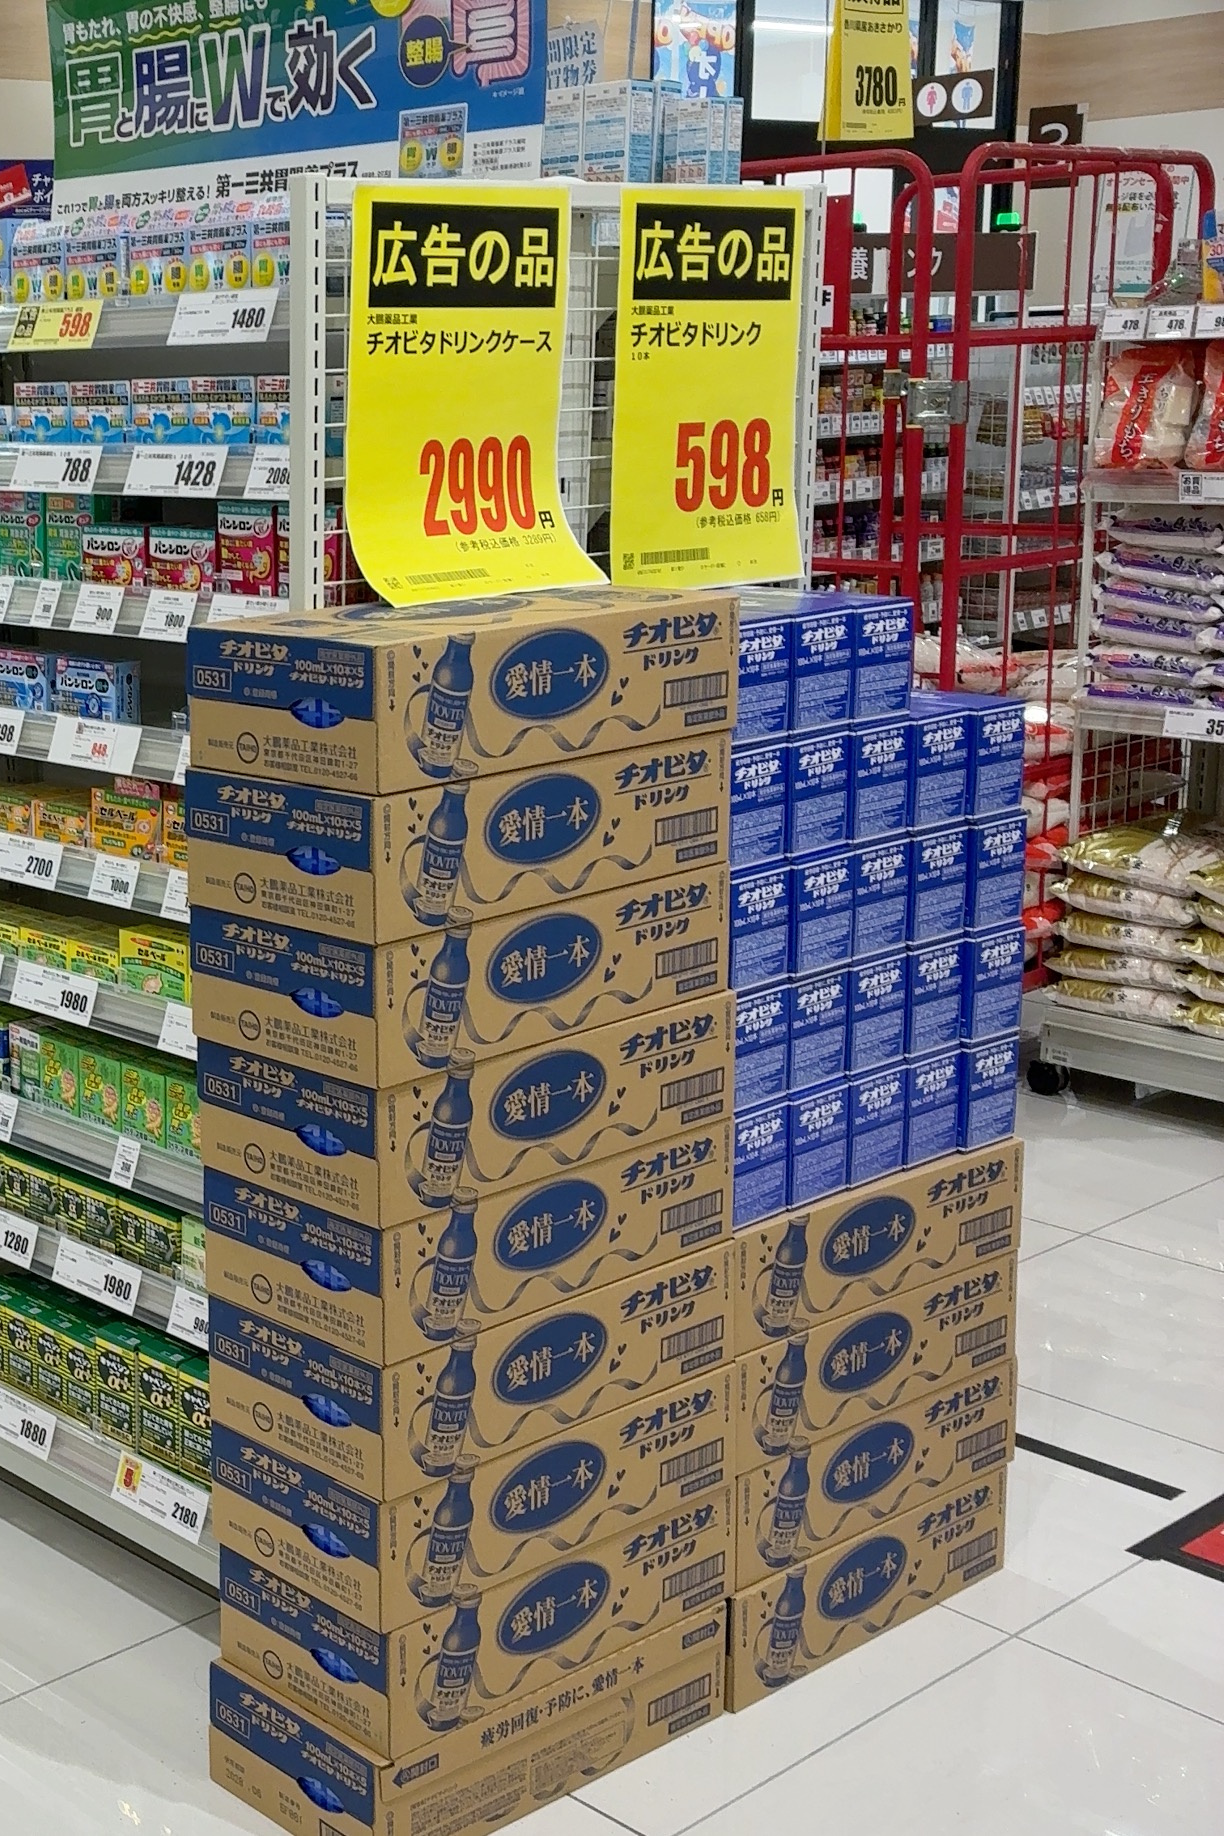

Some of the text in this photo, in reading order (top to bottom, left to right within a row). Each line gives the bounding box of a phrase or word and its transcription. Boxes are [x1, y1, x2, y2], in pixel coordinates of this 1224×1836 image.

[406, 36, 444, 67] 整腸
[373, 222, 555, 288] 広告の品
[636, 220, 792, 283] 広告の品
[59, 311, 93, 338] 598
[231, 308, 266, 331] 1480
[366, 329, 553, 356] チオビタドリンクケース
[630, 321, 762, 349] チオビタドリンク
[61, 457, 92, 484] 788
[174, 460, 217, 488] 1428
[622, 611, 720, 648] チオビタ
[801, 624, 847, 646] チオビタ
[862, 615, 909, 637] チオビタ
[219, 639, 289, 662] チオビタ
[642, 648, 699, 671] ドリンク
[196, 671, 227, 688] 0531
[233, 661, 275, 677] ドリンク
[505, 655, 598, 700] 愛情一本
[614, 749, 709, 789] チオビタ
[734, 761, 782, 783] チオビタ
[217, 783, 287, 808] チオビタ
[634, 785, 689, 810] ドリンク
[193, 812, 225, 832] 0531
[498, 796, 590, 846] 愛情一本
[25, 855, 54, 878] 2700
[615, 882, 710, 923] チオビタ
[222, 921, 292, 950] チオビタ
[199, 947, 230, 966] 0531
[500, 935, 591, 985] 愛情一本
[60, 988, 89, 1014] 1980
[619, 1013, 714, 1060] チオビタ
[229, 1054, 297, 1087] チオビタ
[206, 1078, 236, 1099] 0531
[502, 1074, 594, 1125] 愛情一本
[620, 1137, 714, 1181] チオビタ
[927, 1159, 1006, 1202] チオビタ
[941, 1190, 989, 1218] ドリンク
[3, 1229, 29, 1255] 1280
[506, 1205, 596, 1255] 愛情一本
[832, 1214, 906, 1253] 愛情一本
[102, 1276, 132, 1302] 1980
[620, 1265, 714, 1314] チオビタ
[923, 1270, 1002, 1316] チオビタ
[505, 1335, 595, 1386] 愛情一本
[830, 1328, 903, 1380] 愛情一本
[924, 1375, 1003, 1423] チオビタ
[619, 1389, 712, 1443] チオビタ
[19, 1417, 47, 1447] 1880
[218, 1463, 248, 1489] 0531
[833, 1438, 905, 1491] 愛情一本
[504, 1461, 594, 1516] 愛情一本
[171, 1501, 199, 1529] 2180
[917, 1485, 992, 1535] チオビタ
[622, 1504, 717, 1559] チオビタ
[642, 1543, 696, 1576] ドリンク
[828, 1551, 898, 1607] 愛情一本
[228, 1582, 256, 1611] 0531
[509, 1580, 598, 1639] 愛情一本
[218, 1704, 247, 1733] 0531
[239, 1691, 303, 1737] チオビタ
[251, 1716, 288, 1744] ドリンク
